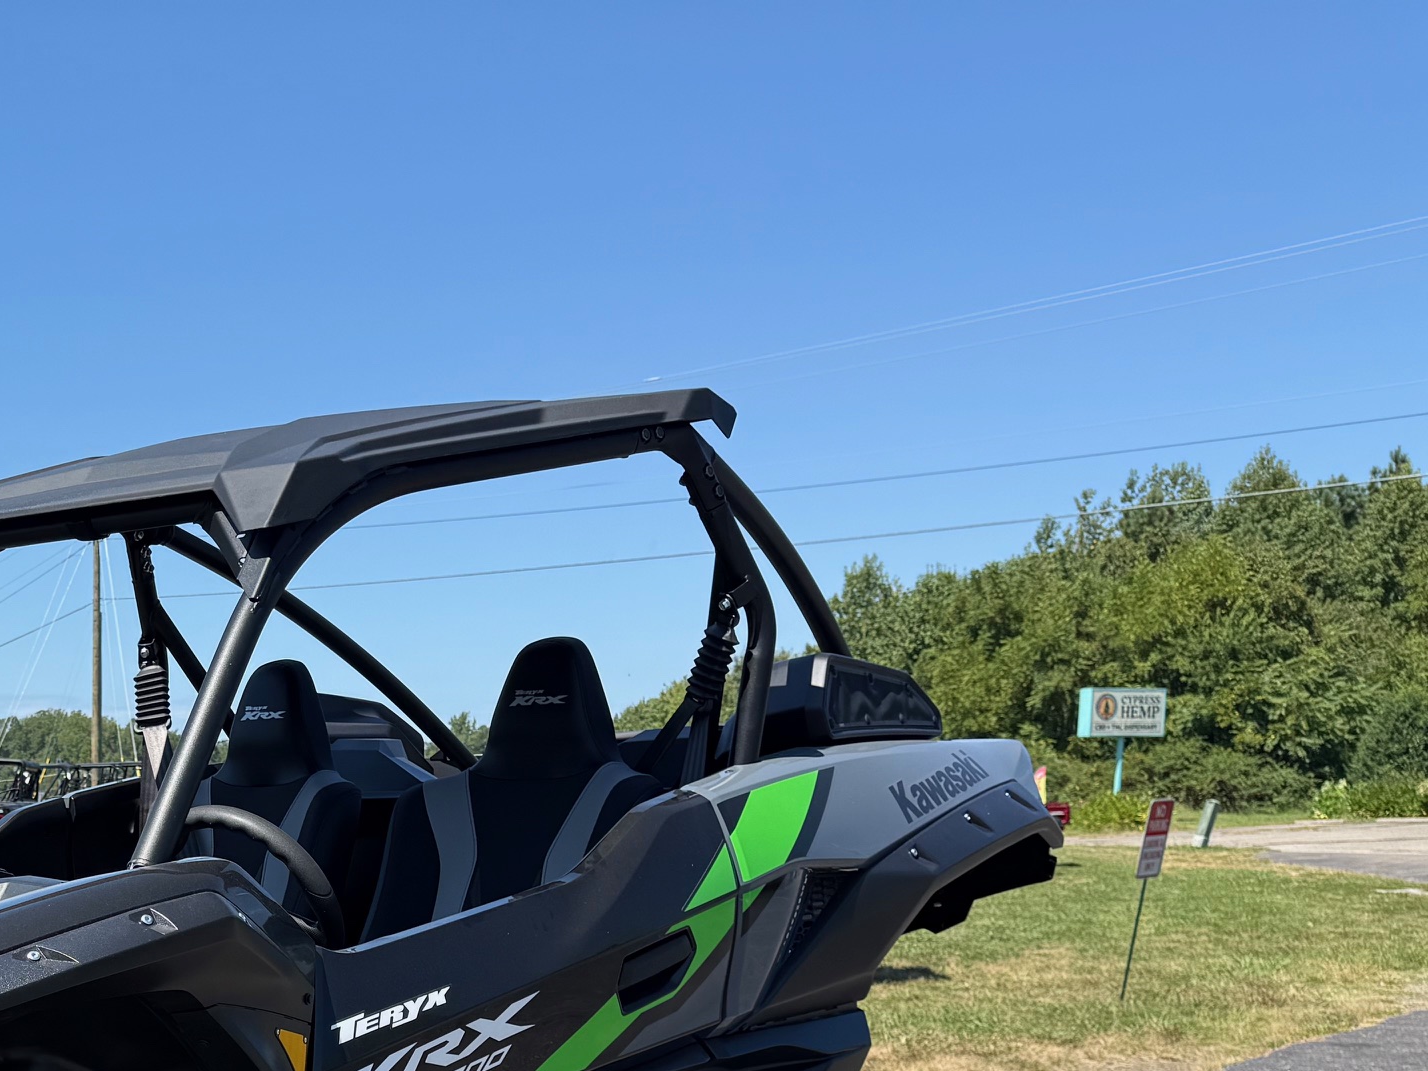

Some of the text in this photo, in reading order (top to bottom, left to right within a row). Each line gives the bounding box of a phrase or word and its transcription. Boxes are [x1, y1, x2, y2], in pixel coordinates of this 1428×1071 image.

[509, 695, 568, 707] KRX
[1121, 694, 1162, 705] CYPRESS
[240, 711, 286, 721] KRX
[1121, 705, 1160, 719] HEMP
[888, 749, 990, 824] Kawasaki
[331, 984, 451, 1045] TERYX
